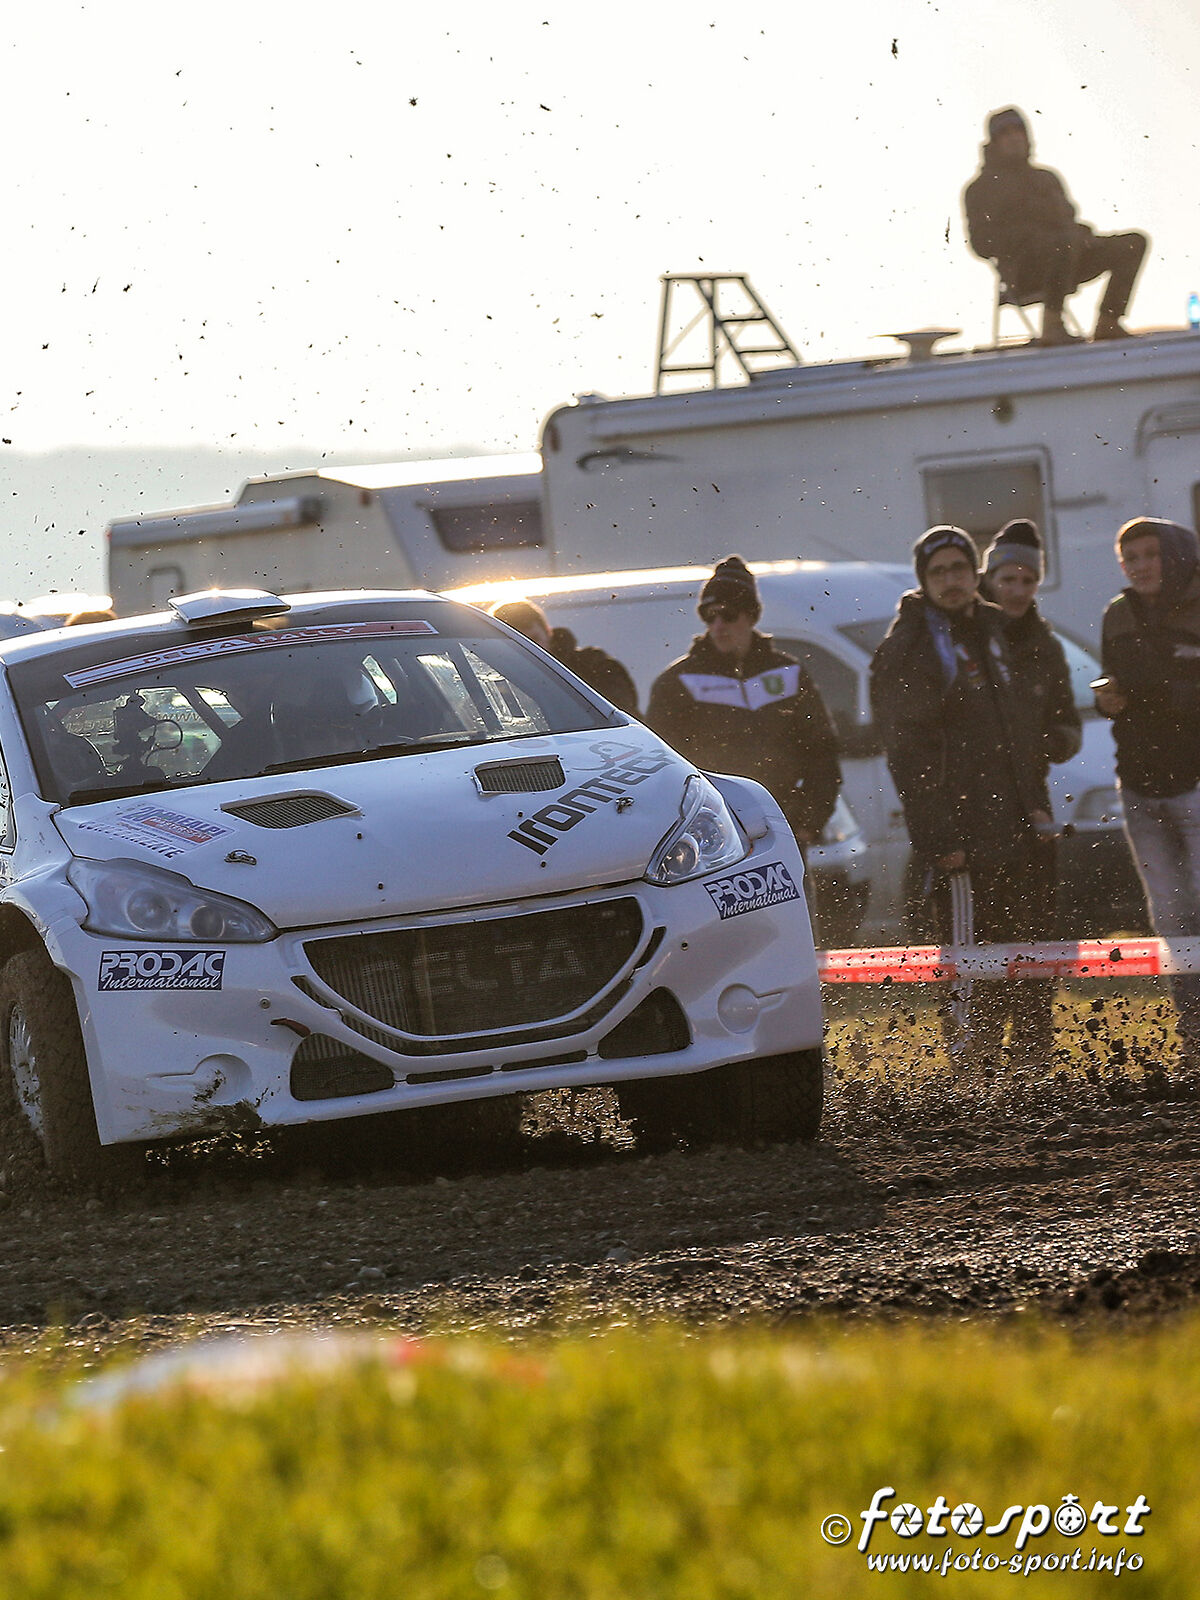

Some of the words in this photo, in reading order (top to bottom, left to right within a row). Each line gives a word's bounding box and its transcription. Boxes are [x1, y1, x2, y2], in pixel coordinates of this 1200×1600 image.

[142, 641, 241, 664] DELTA
[257, 627, 354, 643] RALLY
[706, 863, 793, 909] PRODAC
[720, 887, 797, 917] International
[101, 952, 224, 977] PRODAC
[101, 972, 221, 989] International
